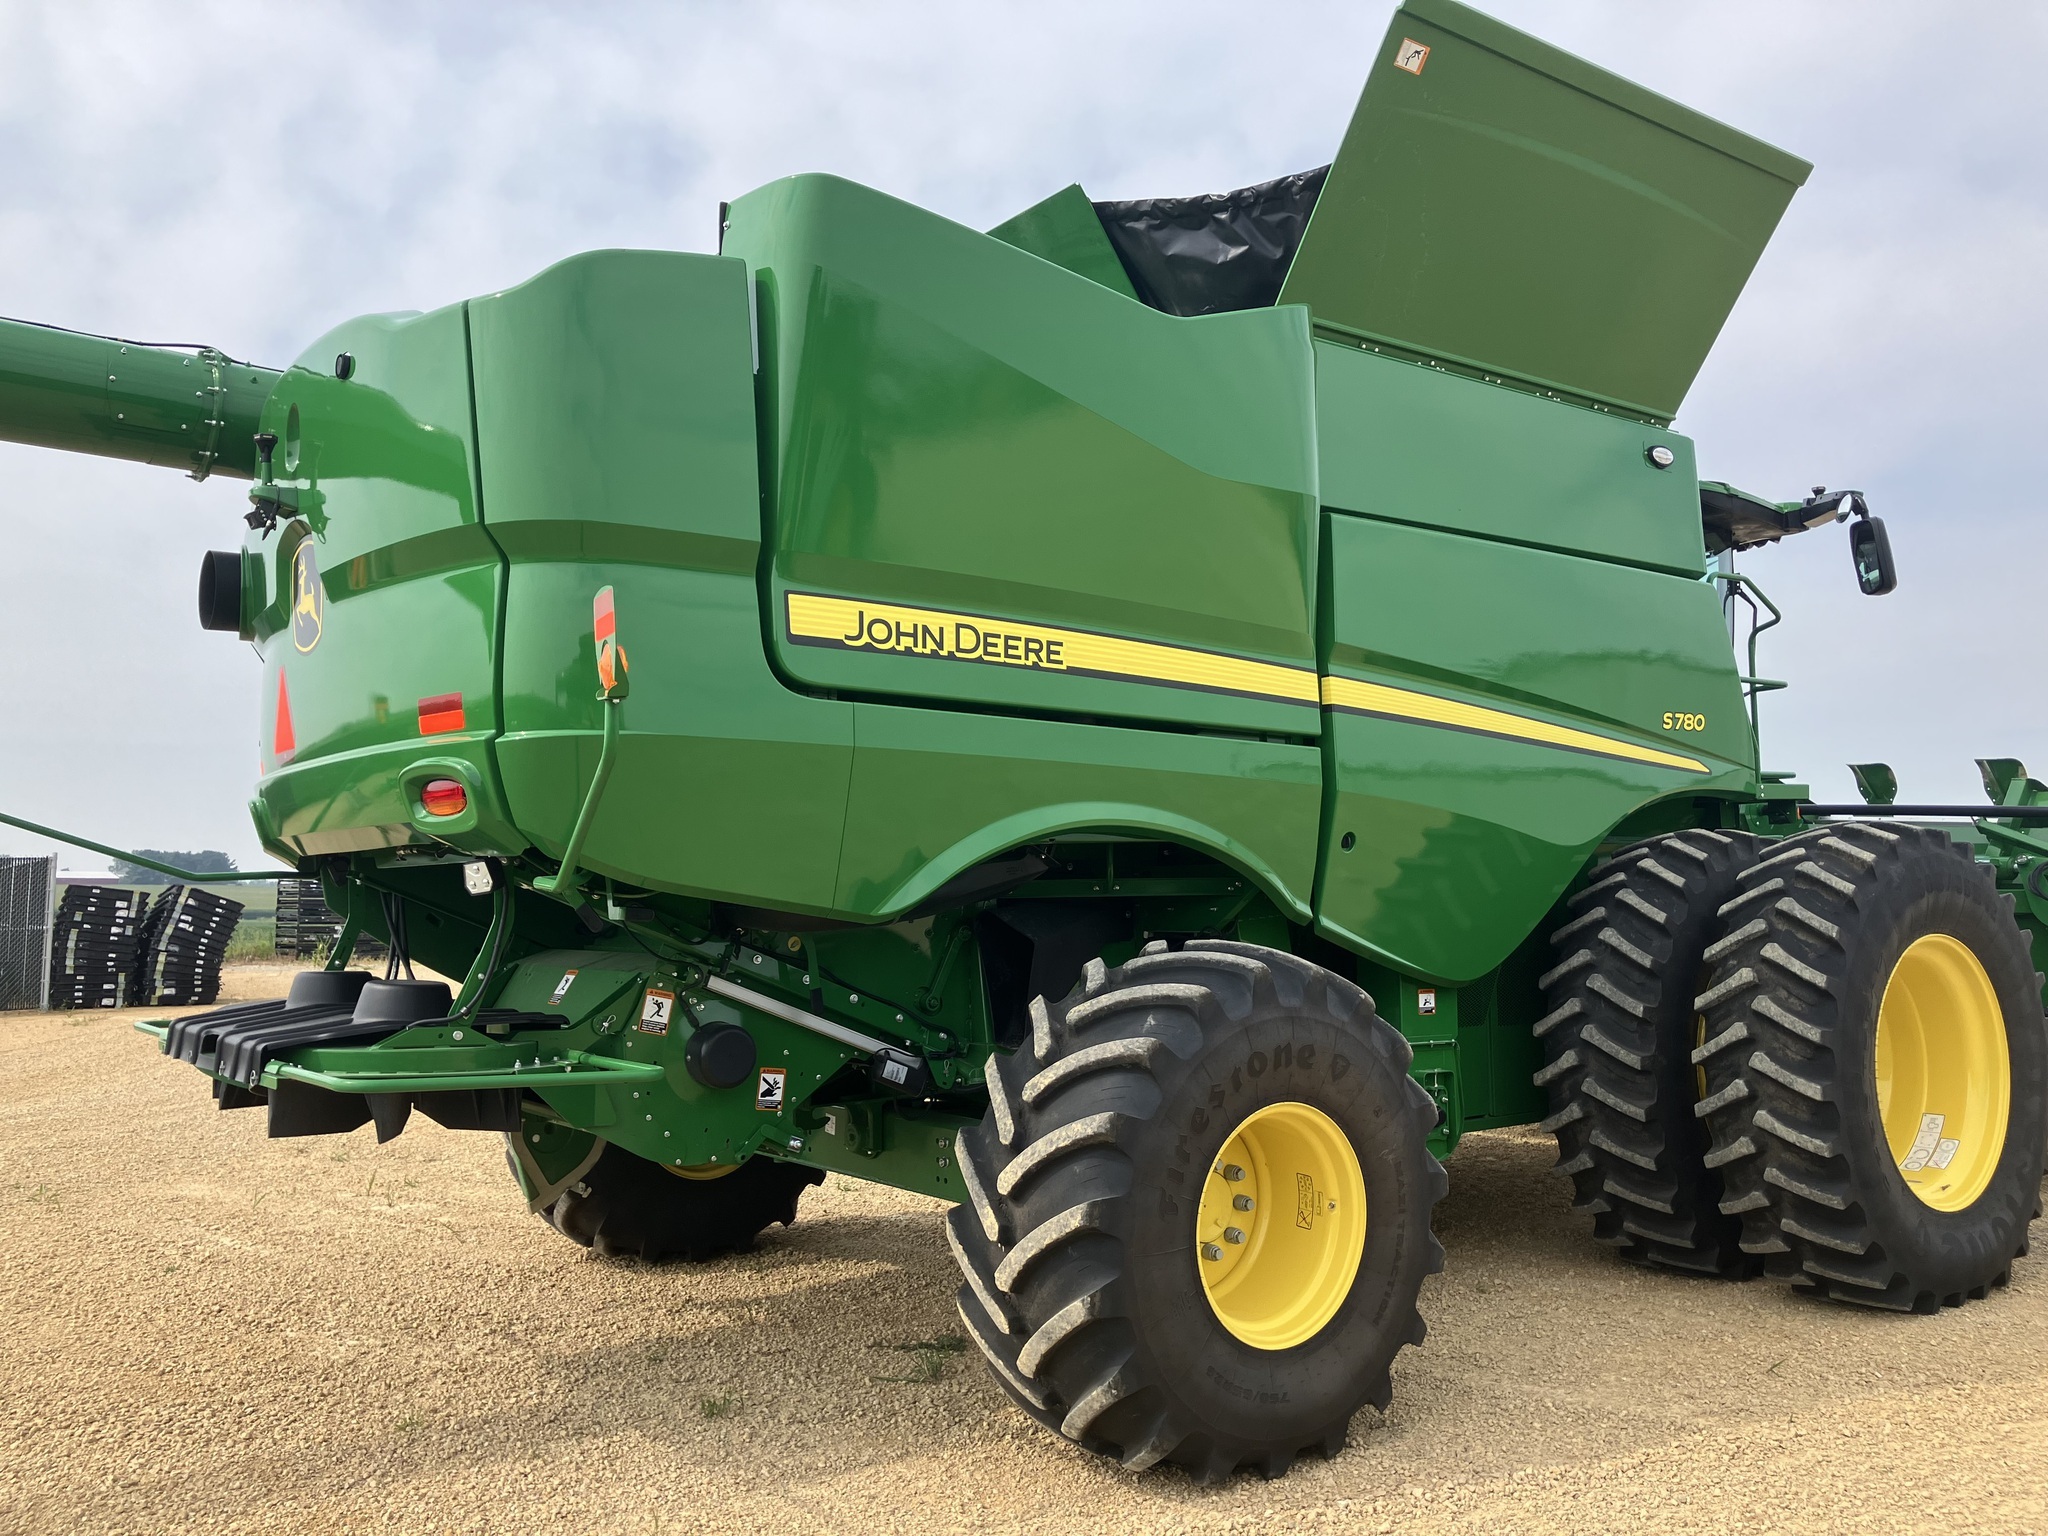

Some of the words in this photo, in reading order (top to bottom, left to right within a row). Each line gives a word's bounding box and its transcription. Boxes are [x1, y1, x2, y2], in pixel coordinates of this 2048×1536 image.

[844, 610, 946, 653] JOHN
[955, 622, 1065, 666] DEERE
[1662, 711, 1707, 732] S780
[1158, 1041, 1317, 1219] Firestone
